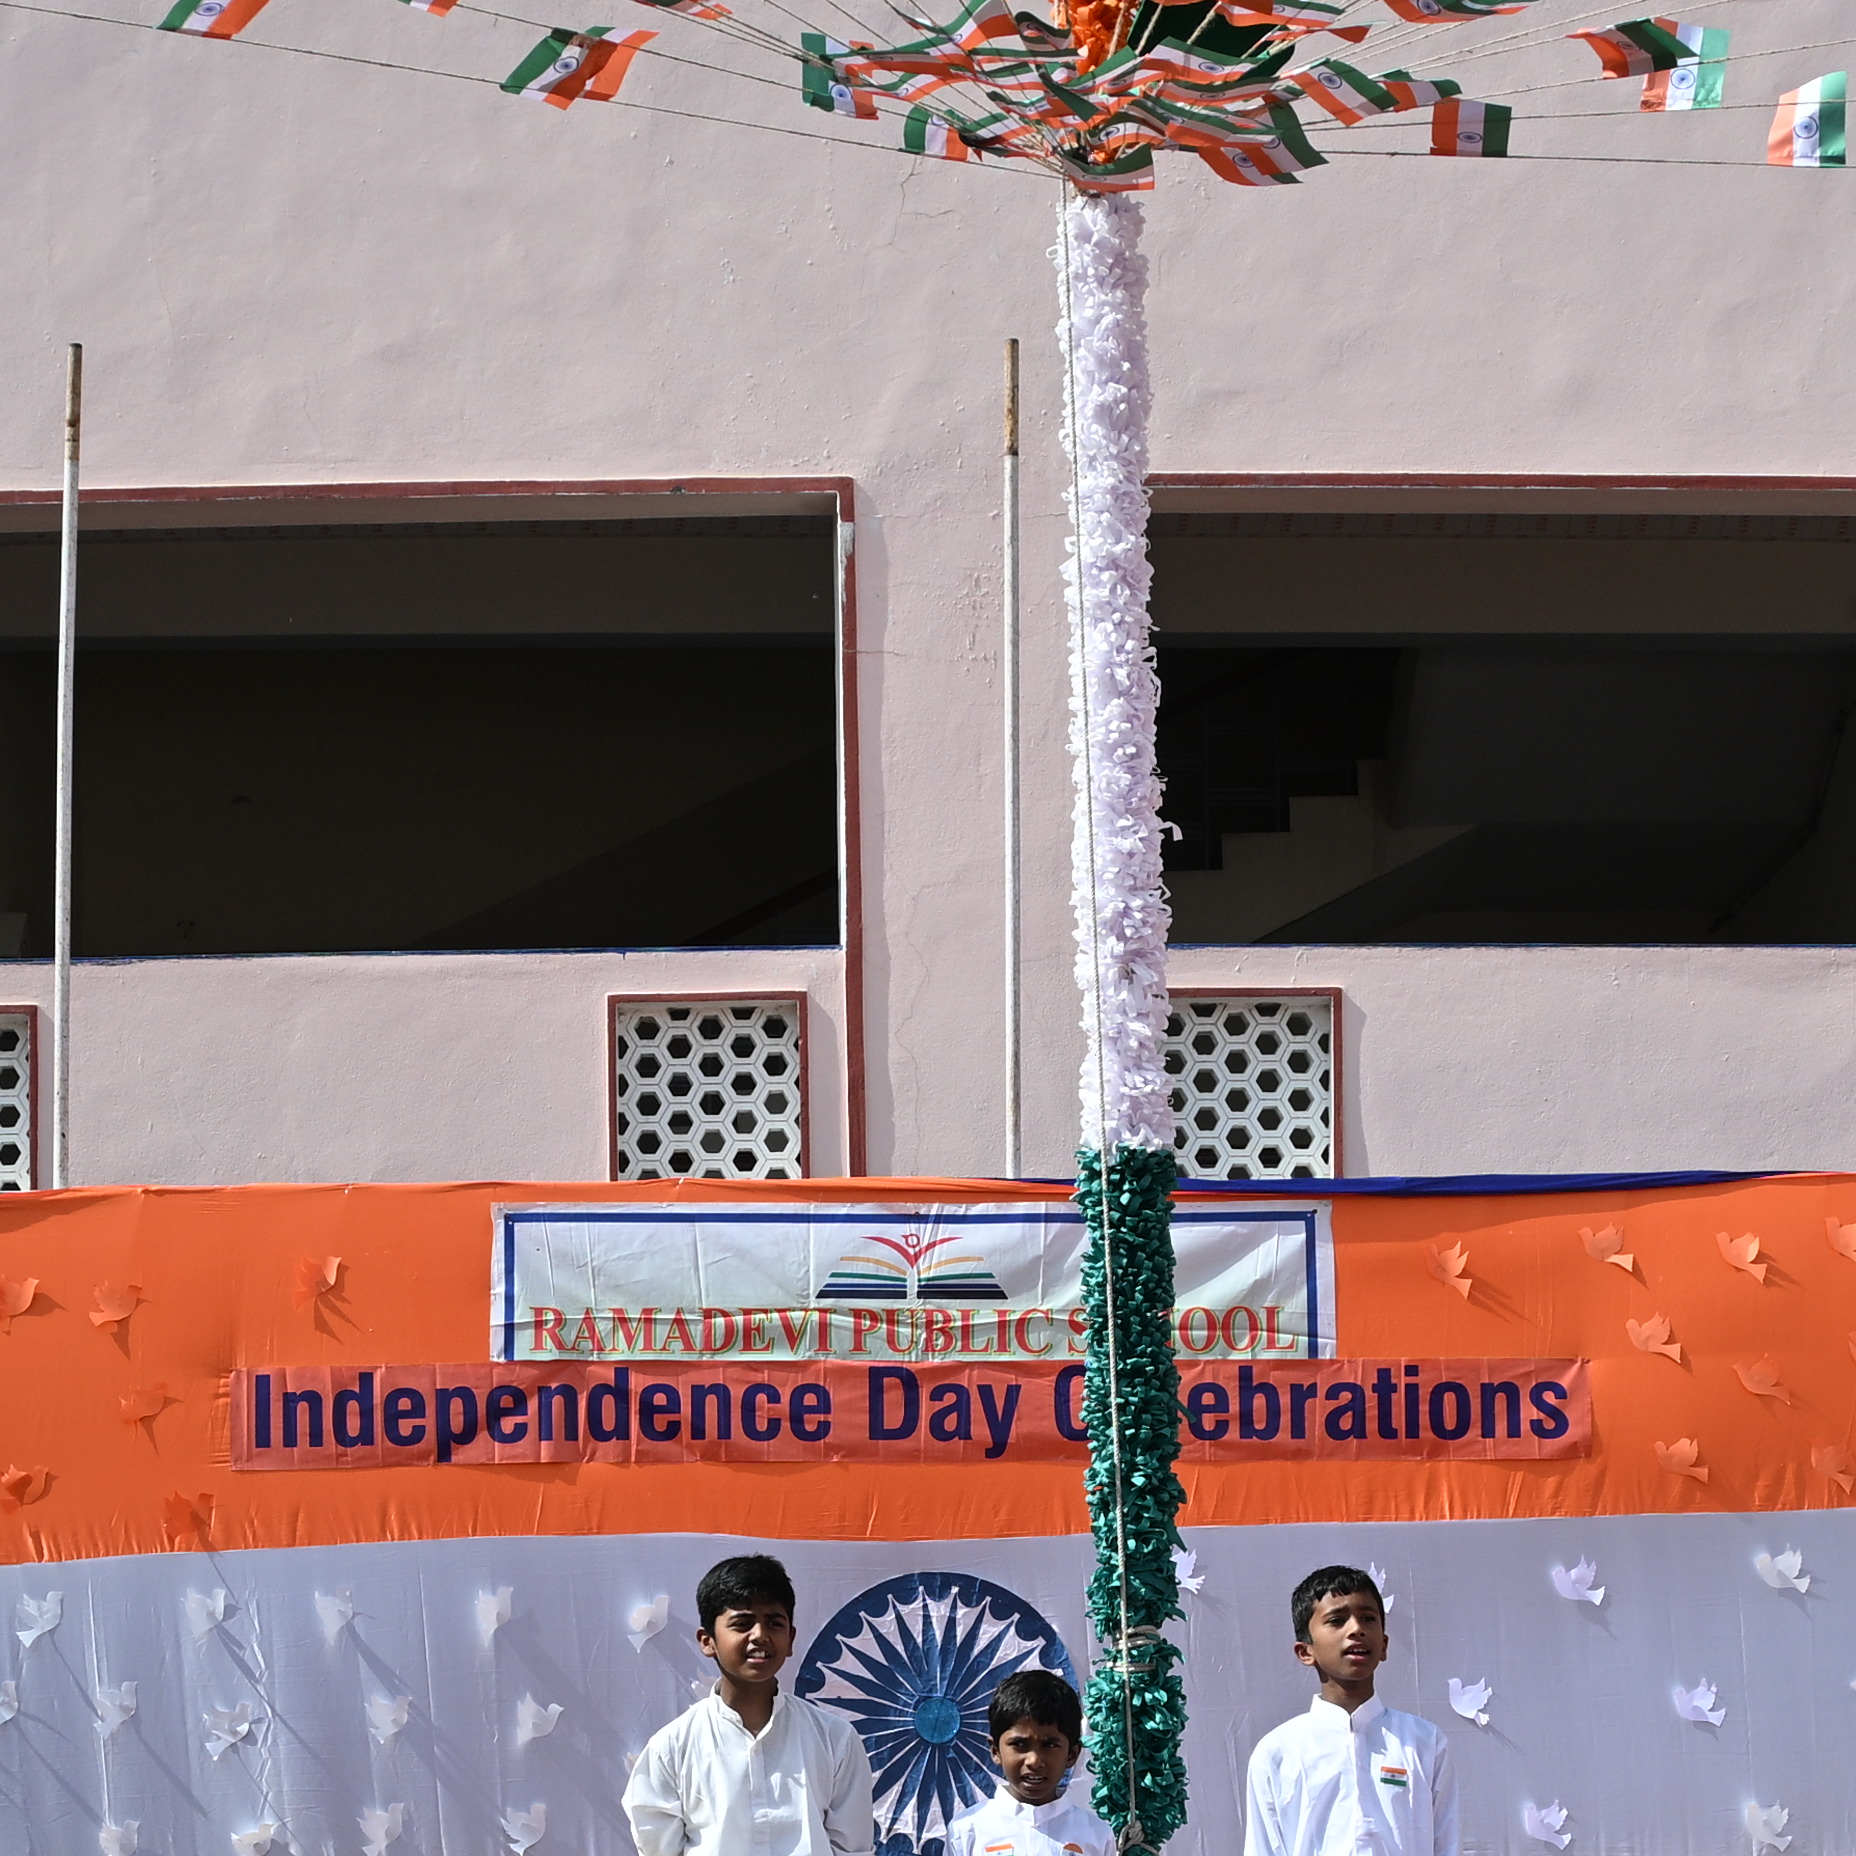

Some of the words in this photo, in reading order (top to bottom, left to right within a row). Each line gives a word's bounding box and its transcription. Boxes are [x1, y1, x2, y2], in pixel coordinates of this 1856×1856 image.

[530, 1306, 836, 1356] RAMADEVI
[848, 1305, 1054, 1355] PUBLIC
[1067, 1304, 1300, 1354] SOOL
[254, 1365, 833, 1463] Independence
[867, 1363, 1023, 1460] Day
[1053, 1363, 1571, 1442] Cebrations
